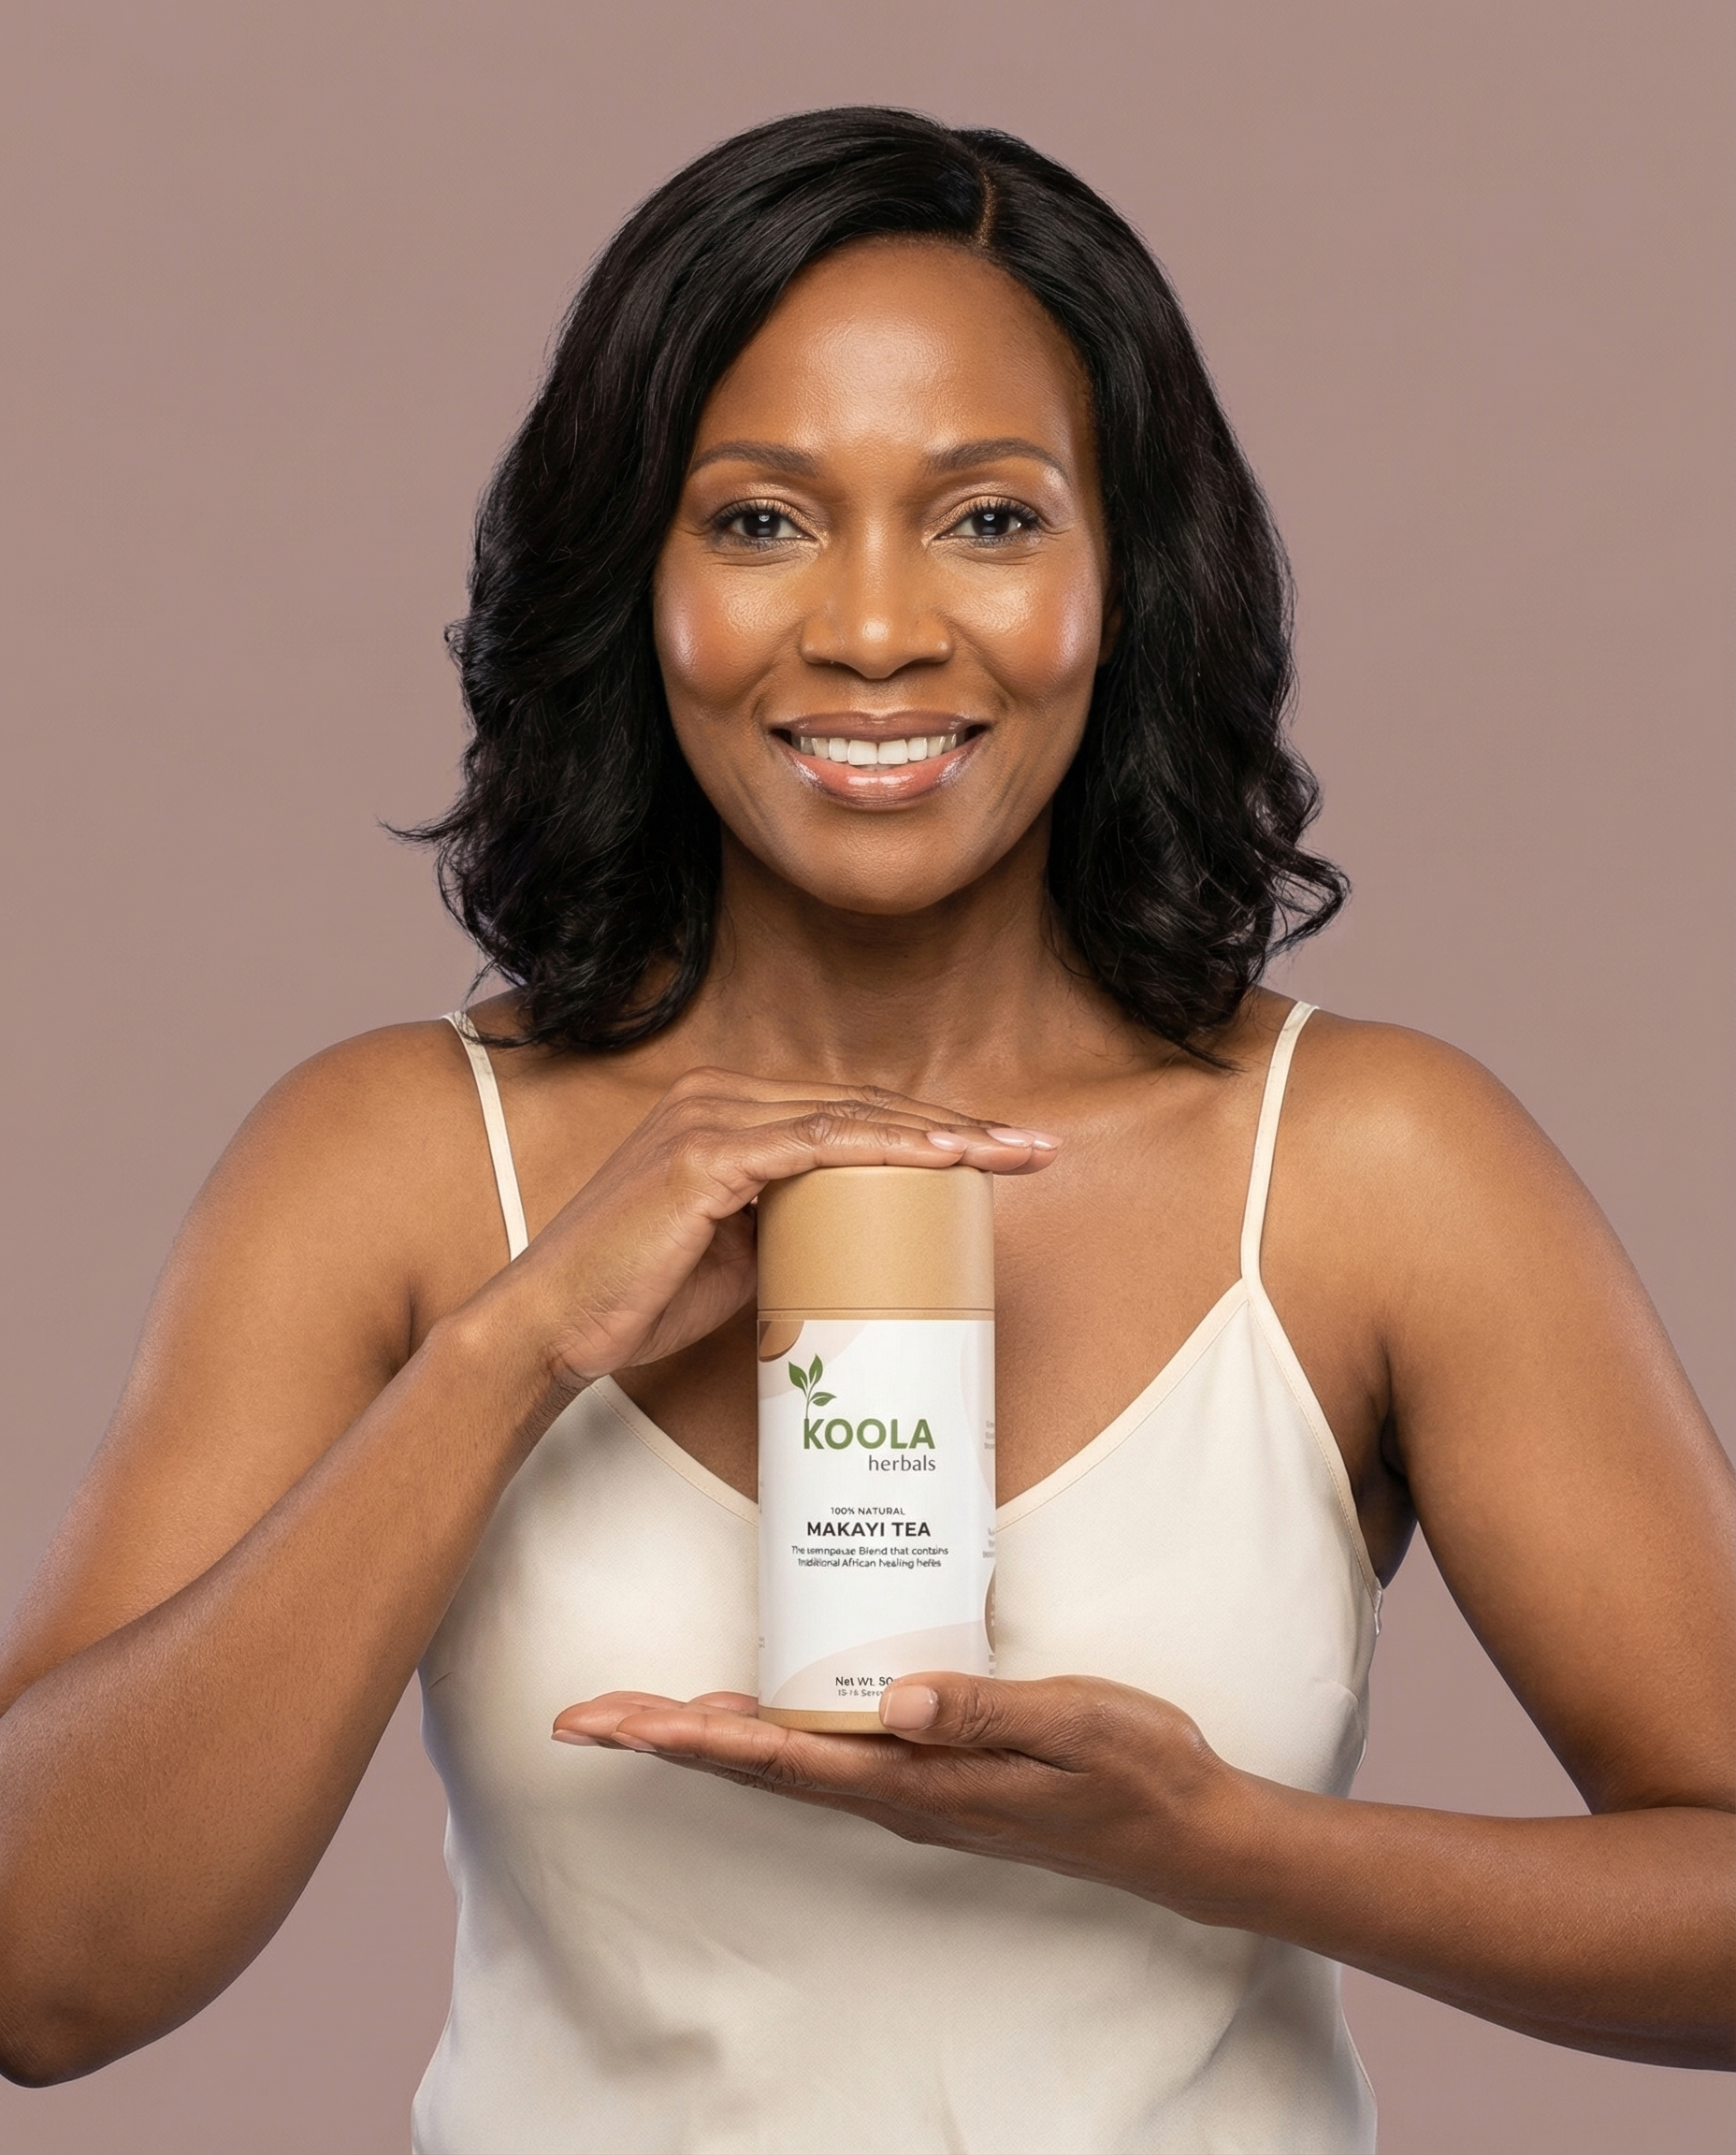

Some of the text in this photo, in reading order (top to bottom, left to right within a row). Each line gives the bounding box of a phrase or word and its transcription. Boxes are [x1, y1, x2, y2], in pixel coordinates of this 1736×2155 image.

[803, 1418, 935, 1450] KOOLA
[868, 1454, 936, 1472] herbals
[831, 1507, 905, 1515] 100% NATURAL
[807, 1522, 932, 1537] MAKAYI TEA
[890, 1546, 909, 1555] that
[842, 1557, 876, 1568] African
[835, 1676, 854, 1686] Net
